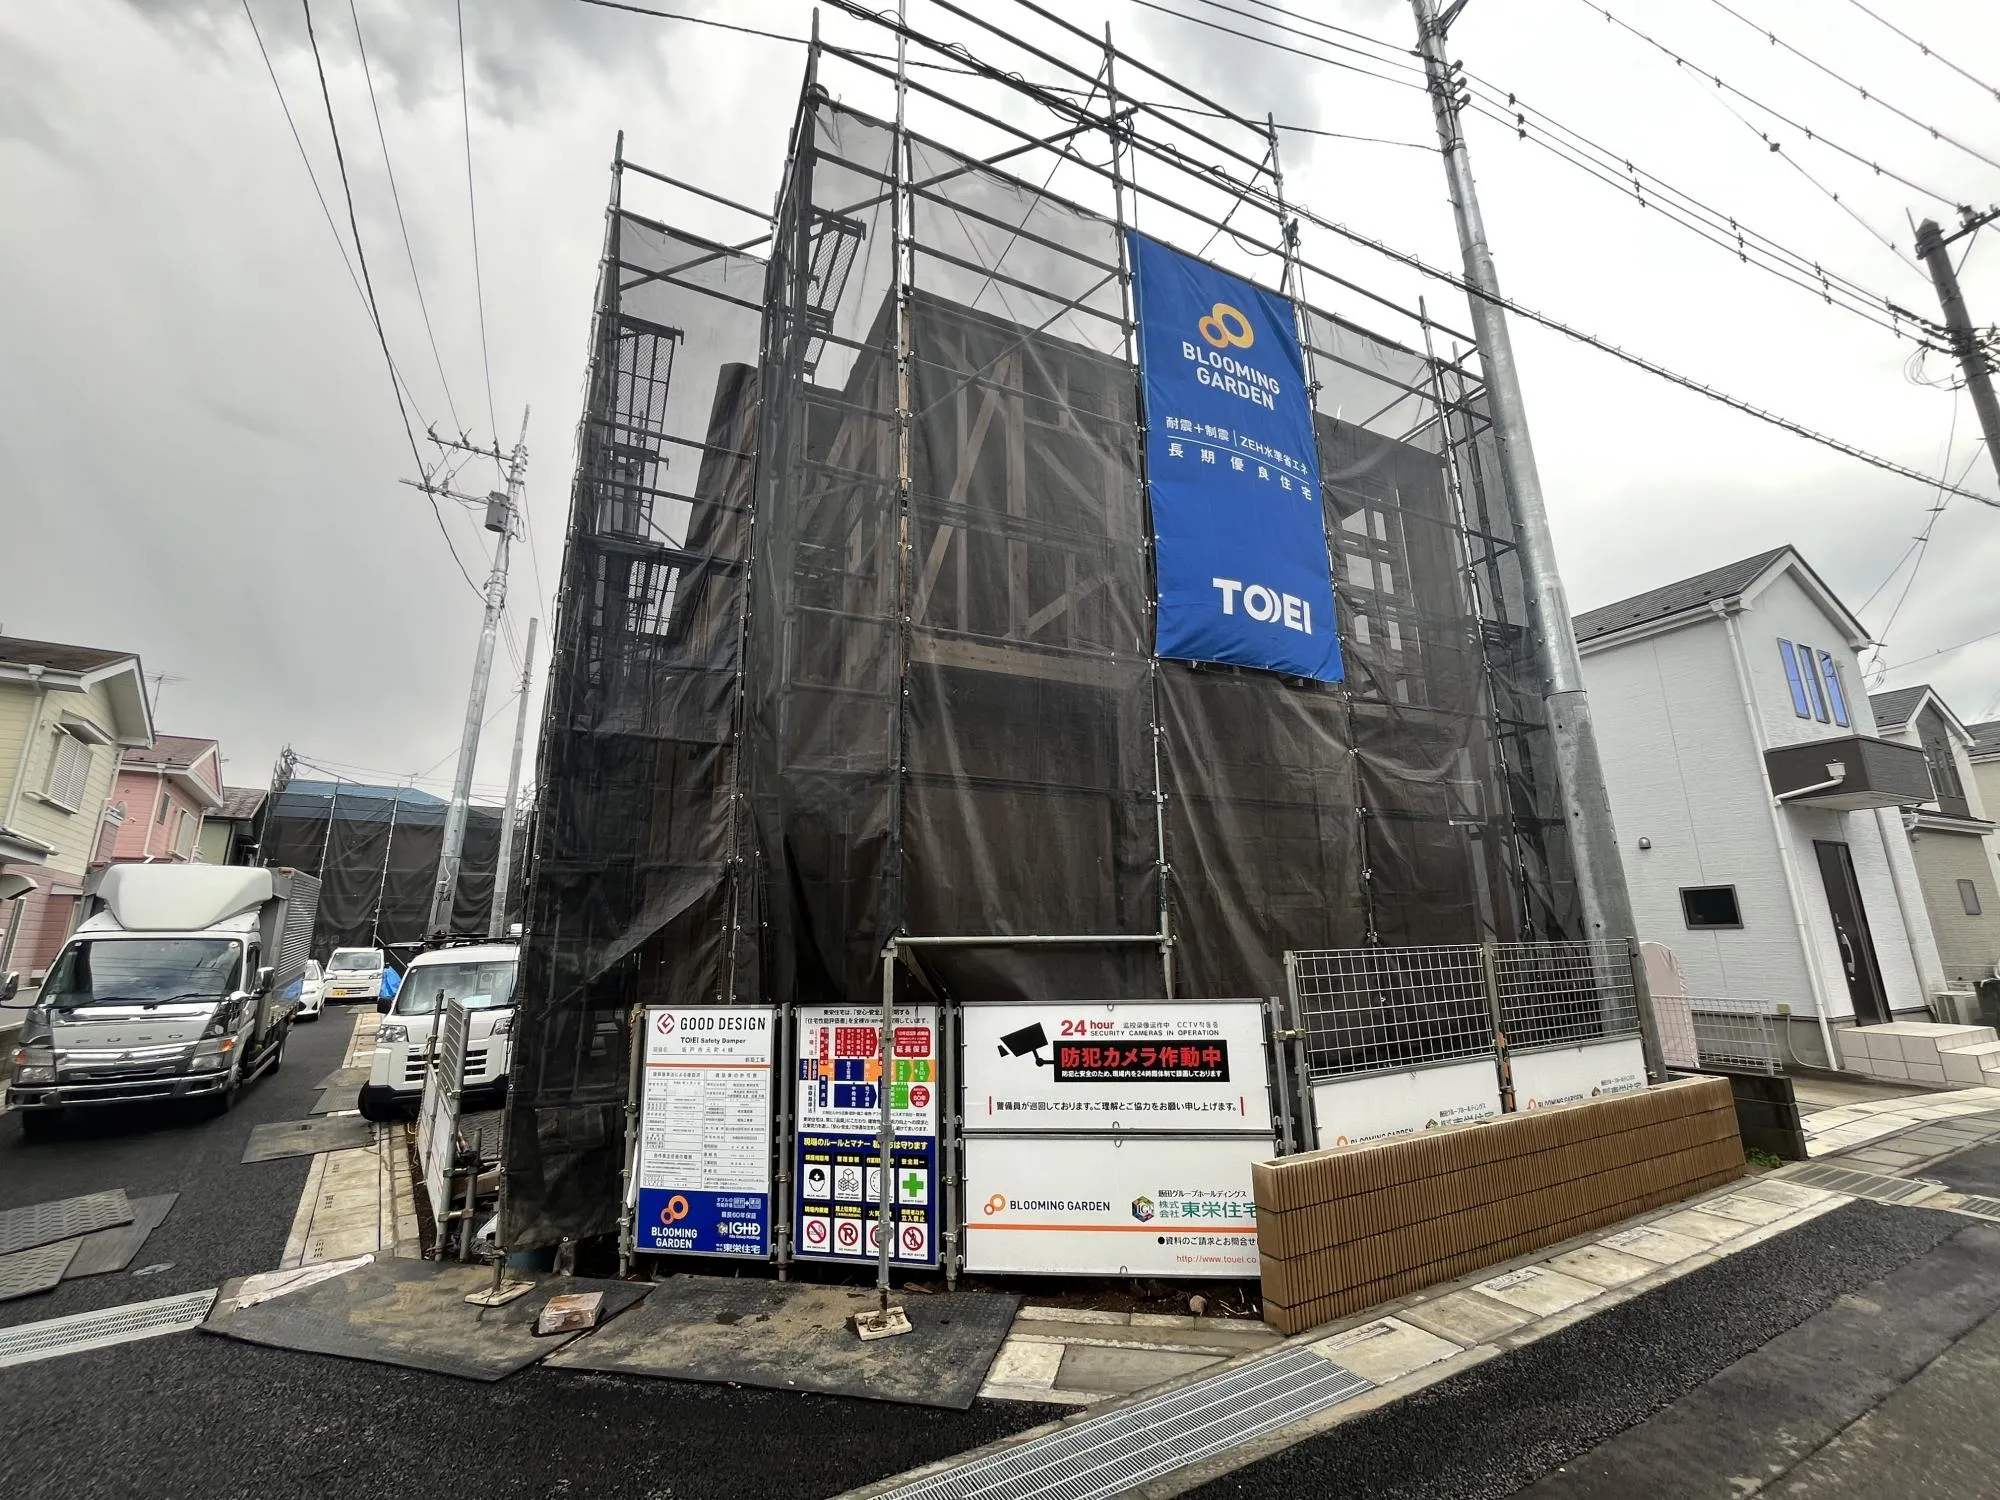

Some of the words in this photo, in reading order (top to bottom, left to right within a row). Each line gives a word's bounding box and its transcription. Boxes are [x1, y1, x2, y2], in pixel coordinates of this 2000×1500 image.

[1182, 340, 1281, 396] BLOOMING
[1195, 365, 1275, 411] GARDEN
[1168, 442, 1312, 500] 長期優良住宅
[1212, 577, 1312, 635] TOEI
[680, 1017, 714, 1030] GOOD
[718, 1017, 766, 1030] DESIGN
[1060, 1020, 1087, 1036] 24
[1090, 1019, 1114, 1030] hour
[76, 1034, 183, 1043] FUSO
[700, 1037, 720, 1045] Safety
[721, 1037, 746, 1045] Damper
[1061, 1046, 1222, 1068] 防犯カメラ作動中
[996, 1101, 1237, 1112] 警備員が巡回しております。ご理解とご協力をお願い申し上げます。
[803, 1137, 871, 1148] 現場のルールとマナー
[872, 1139, 928, 1150] 私ちは守ります
[1158, 1189, 1247, 1198] 飯田グループホールディングス
[1009, 1199, 1065, 1211] BLOOMING
[1067, 1200, 1110, 1212] GARDEN
[1181, 1201, 1257, 1219] 東栄住宅
[651, 1226, 698, 1238] BLOOMING
[655, 1238, 692, 1248] GARDEN
[723, 1243, 761, 1254] 東栄住宅
